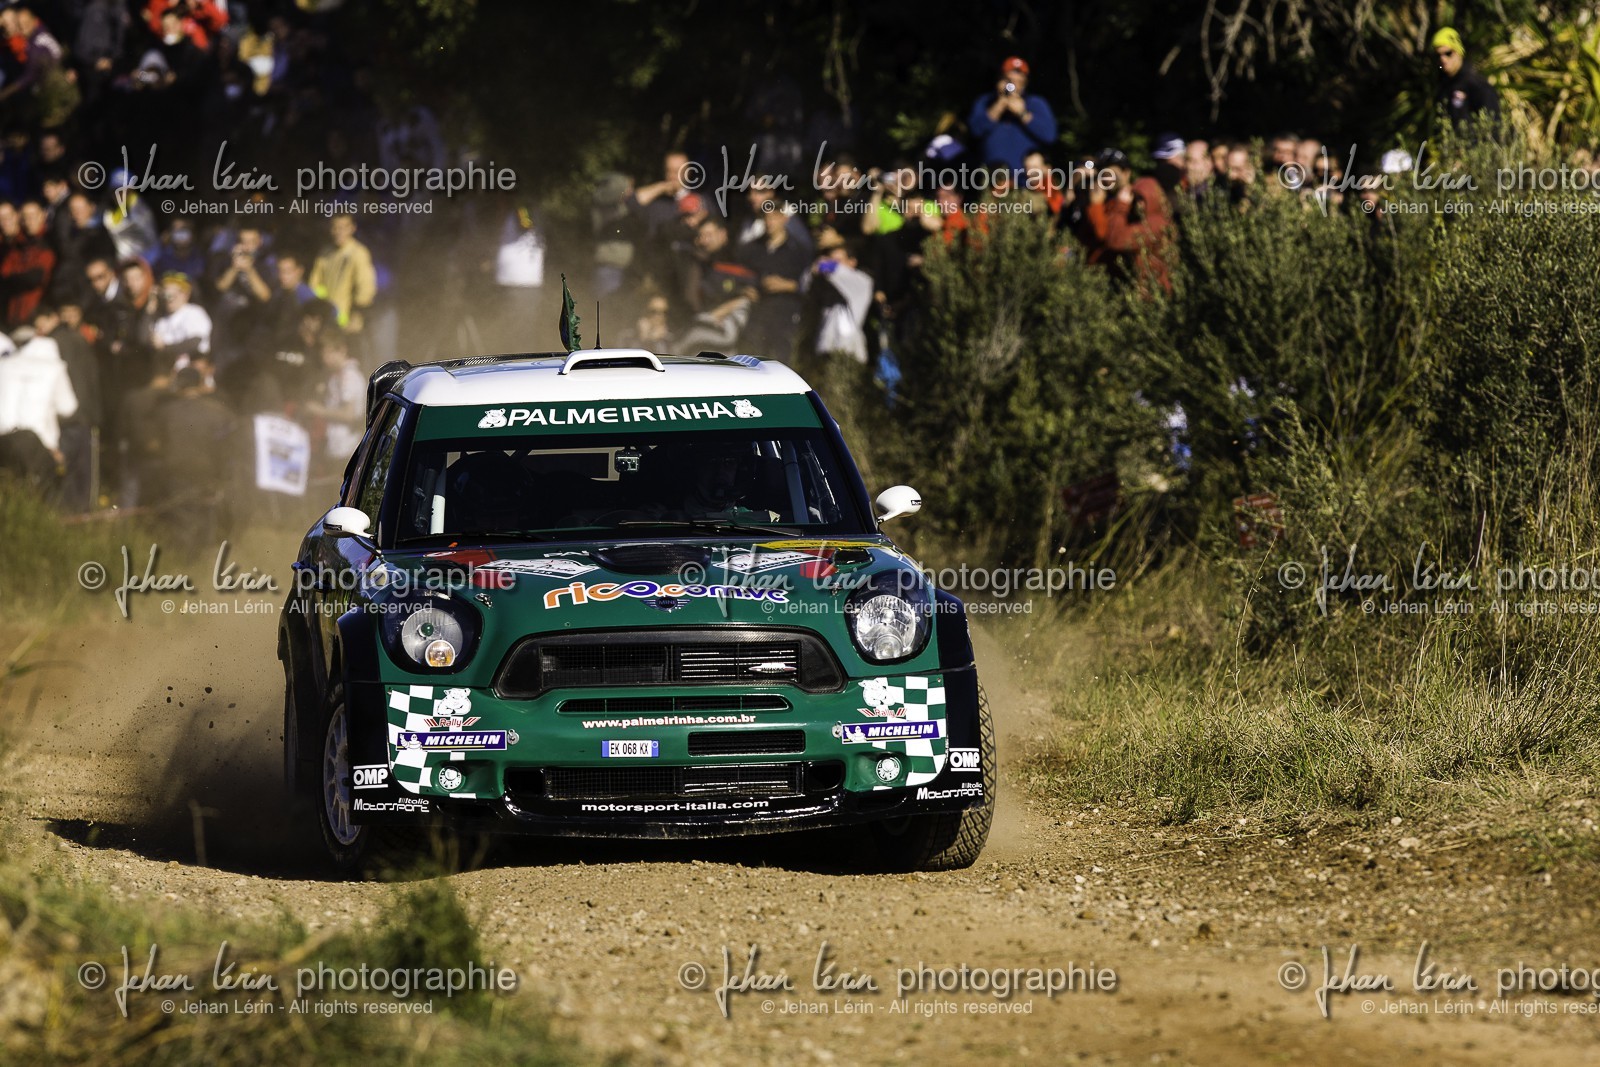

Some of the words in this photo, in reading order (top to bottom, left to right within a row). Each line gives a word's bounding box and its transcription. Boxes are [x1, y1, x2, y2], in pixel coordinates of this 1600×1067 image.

[507, 401, 734, 427] PALMEIRINHA
[439, 717, 463, 729] Rally
[582, 714, 757, 729] www.palmeirinha.com.br
[867, 724, 935, 738] MICHELIN
[424, 734, 502, 747] MICHELIN
[610, 742, 620, 755] EK
[622, 742, 637, 755] 068
[639, 742, 649, 755] KX
[950, 751, 980, 768] OMP
[353, 768, 388, 786] OMP
[916, 786, 983, 800] Motorsport
[353, 798, 430, 813] Motorsport
[581, 800, 769, 813] motorsport-italia.com
